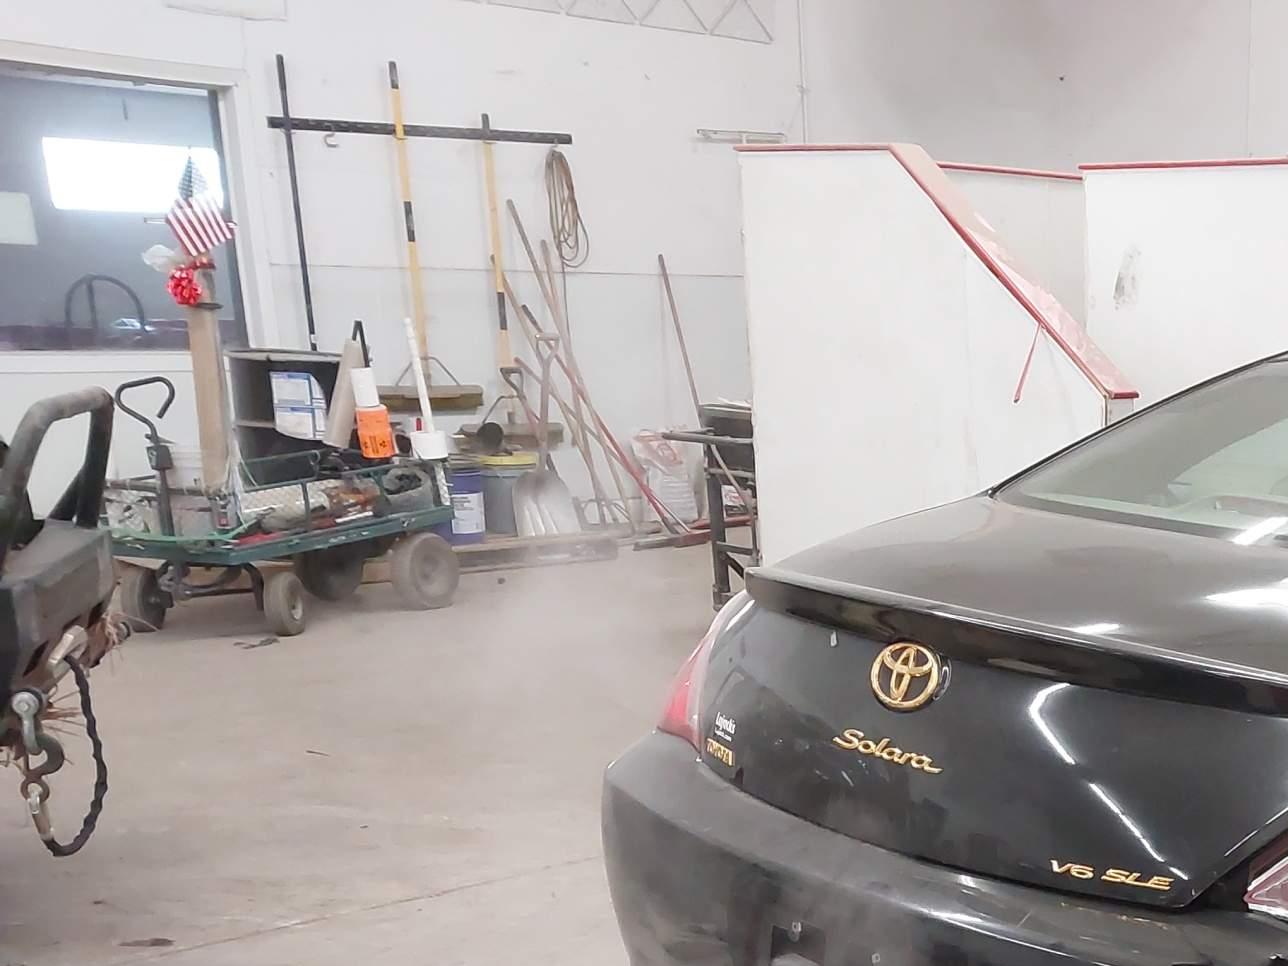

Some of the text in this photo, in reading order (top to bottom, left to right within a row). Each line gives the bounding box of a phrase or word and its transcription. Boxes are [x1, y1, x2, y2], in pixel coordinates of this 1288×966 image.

[832, 728, 944, 774] Solara
[1050, 859, 1175, 891] V6 SLE
